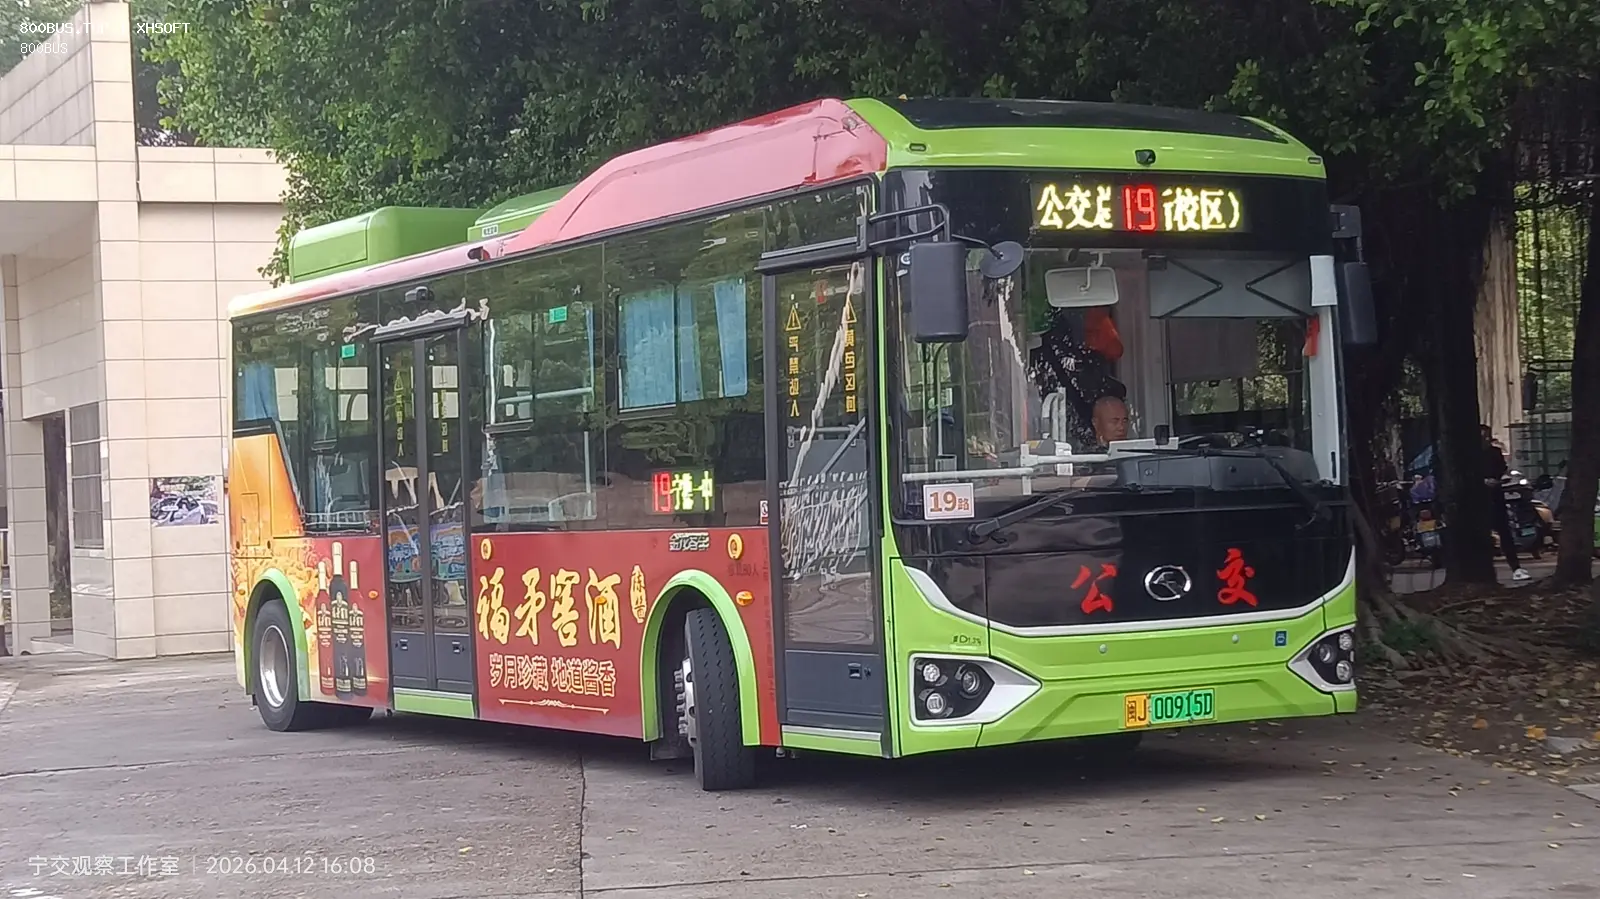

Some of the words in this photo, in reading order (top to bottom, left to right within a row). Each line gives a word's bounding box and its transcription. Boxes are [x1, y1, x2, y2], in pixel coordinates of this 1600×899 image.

[1124, 186, 1155, 231] 19
[930, 491, 969, 512] 19路
[490, 653, 549, 691] 岁月珍藏
[551, 657, 616, 697] 地道酱香
[1155, 692, 1213, 720] 00915D
